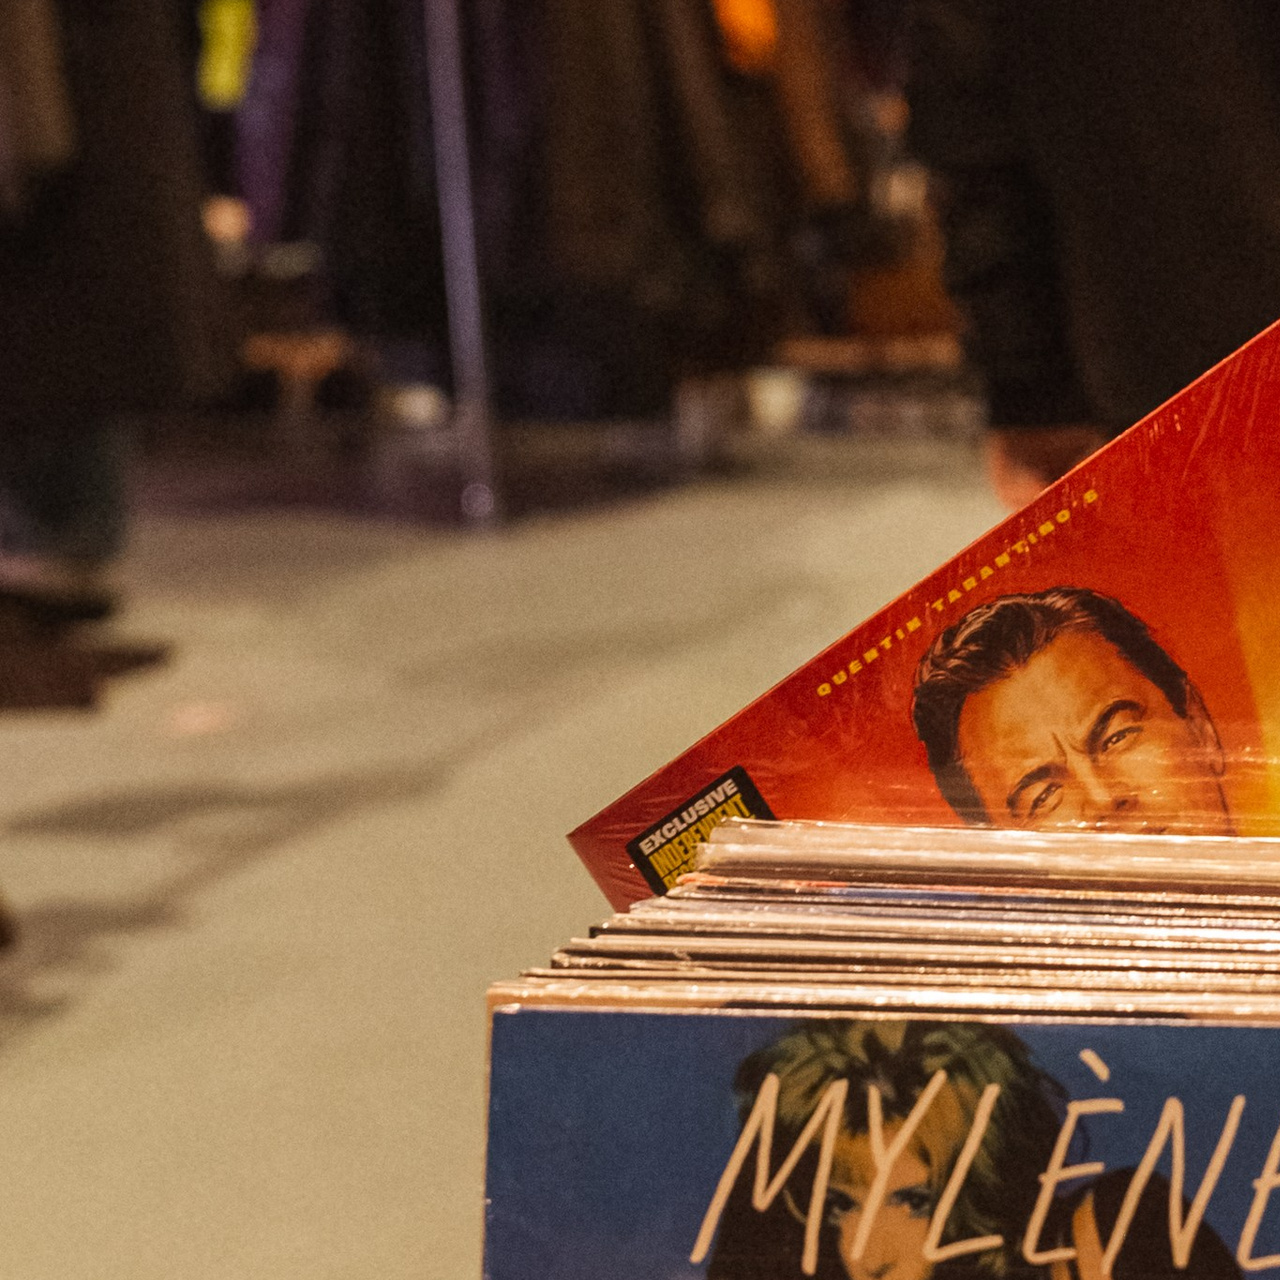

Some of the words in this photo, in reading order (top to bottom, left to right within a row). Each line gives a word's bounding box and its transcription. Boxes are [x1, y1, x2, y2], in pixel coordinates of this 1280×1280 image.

[816, 616, 922, 697] QUENTIN
[931, 488, 1099, 612] TARANTINO'S
[638, 778, 740, 856] EXCLUSIVE
